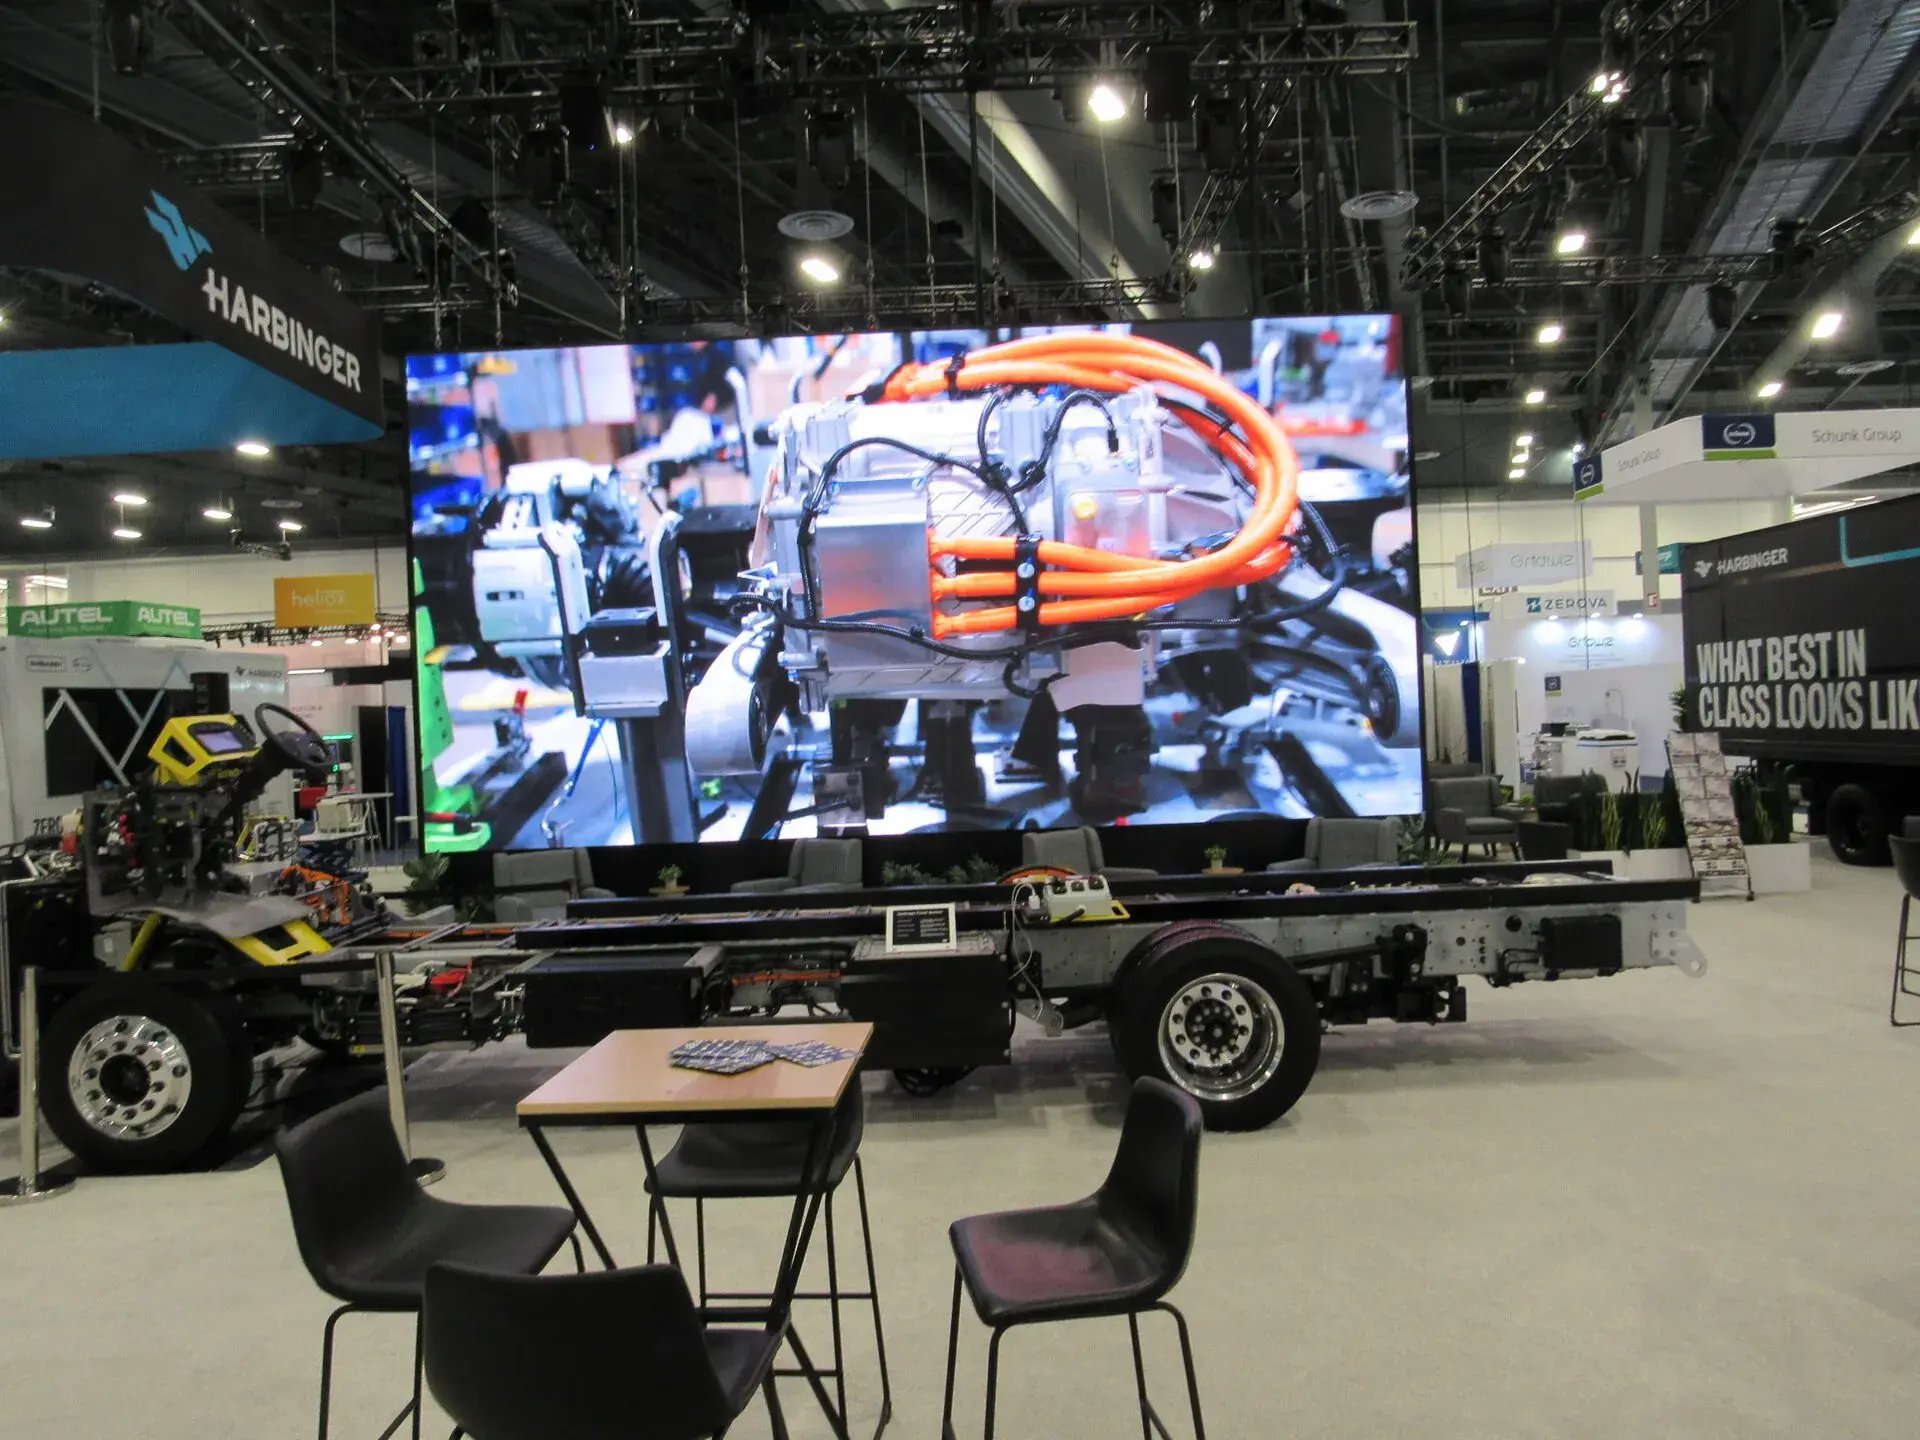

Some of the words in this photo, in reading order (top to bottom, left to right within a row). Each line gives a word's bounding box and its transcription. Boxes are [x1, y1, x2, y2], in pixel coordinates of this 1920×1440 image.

[202, 267, 361, 393] HARBINGER
[1812, 429, 1858, 443] Schunk
[1863, 427, 1902, 443] Group
[1716, 548, 1788, 575] HARBINGER
[19, 606, 113, 626] AUTEL
[1545, 599, 1608, 610] ZEROVA
[138, 607, 195, 626] AUTEL
[1696, 638, 1762, 684] WHAT
[1766, 632, 1832, 681] BEST
[1837, 628, 1866, 678] IN
[1700, 684, 1770, 728] CLASS
[1775, 681, 1864, 729] LOOKS
